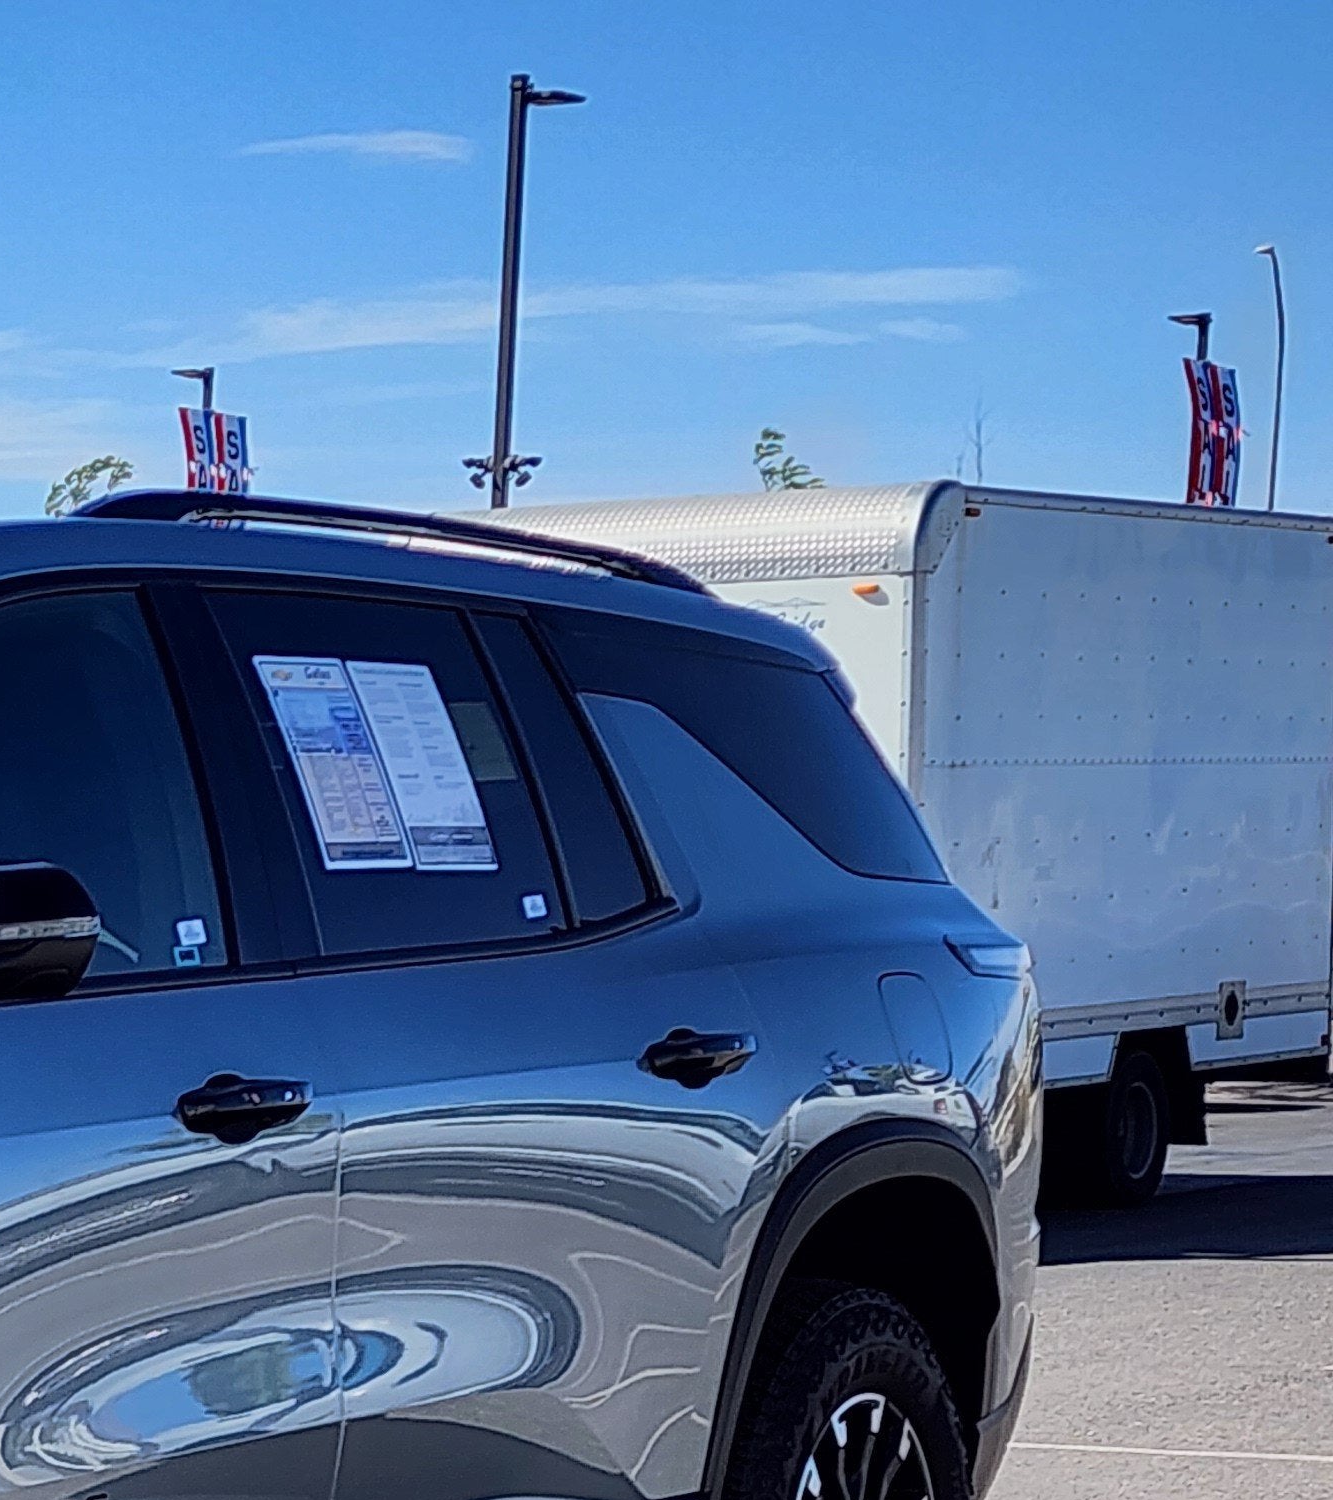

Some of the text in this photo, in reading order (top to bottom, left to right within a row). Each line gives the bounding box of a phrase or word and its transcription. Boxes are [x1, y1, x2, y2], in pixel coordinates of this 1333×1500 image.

[193, 424, 207, 489] SA
[226, 430, 240, 492] SA
[1197, 376, 1212, 500] SAL
[1222, 383, 1235, 505] SAL
